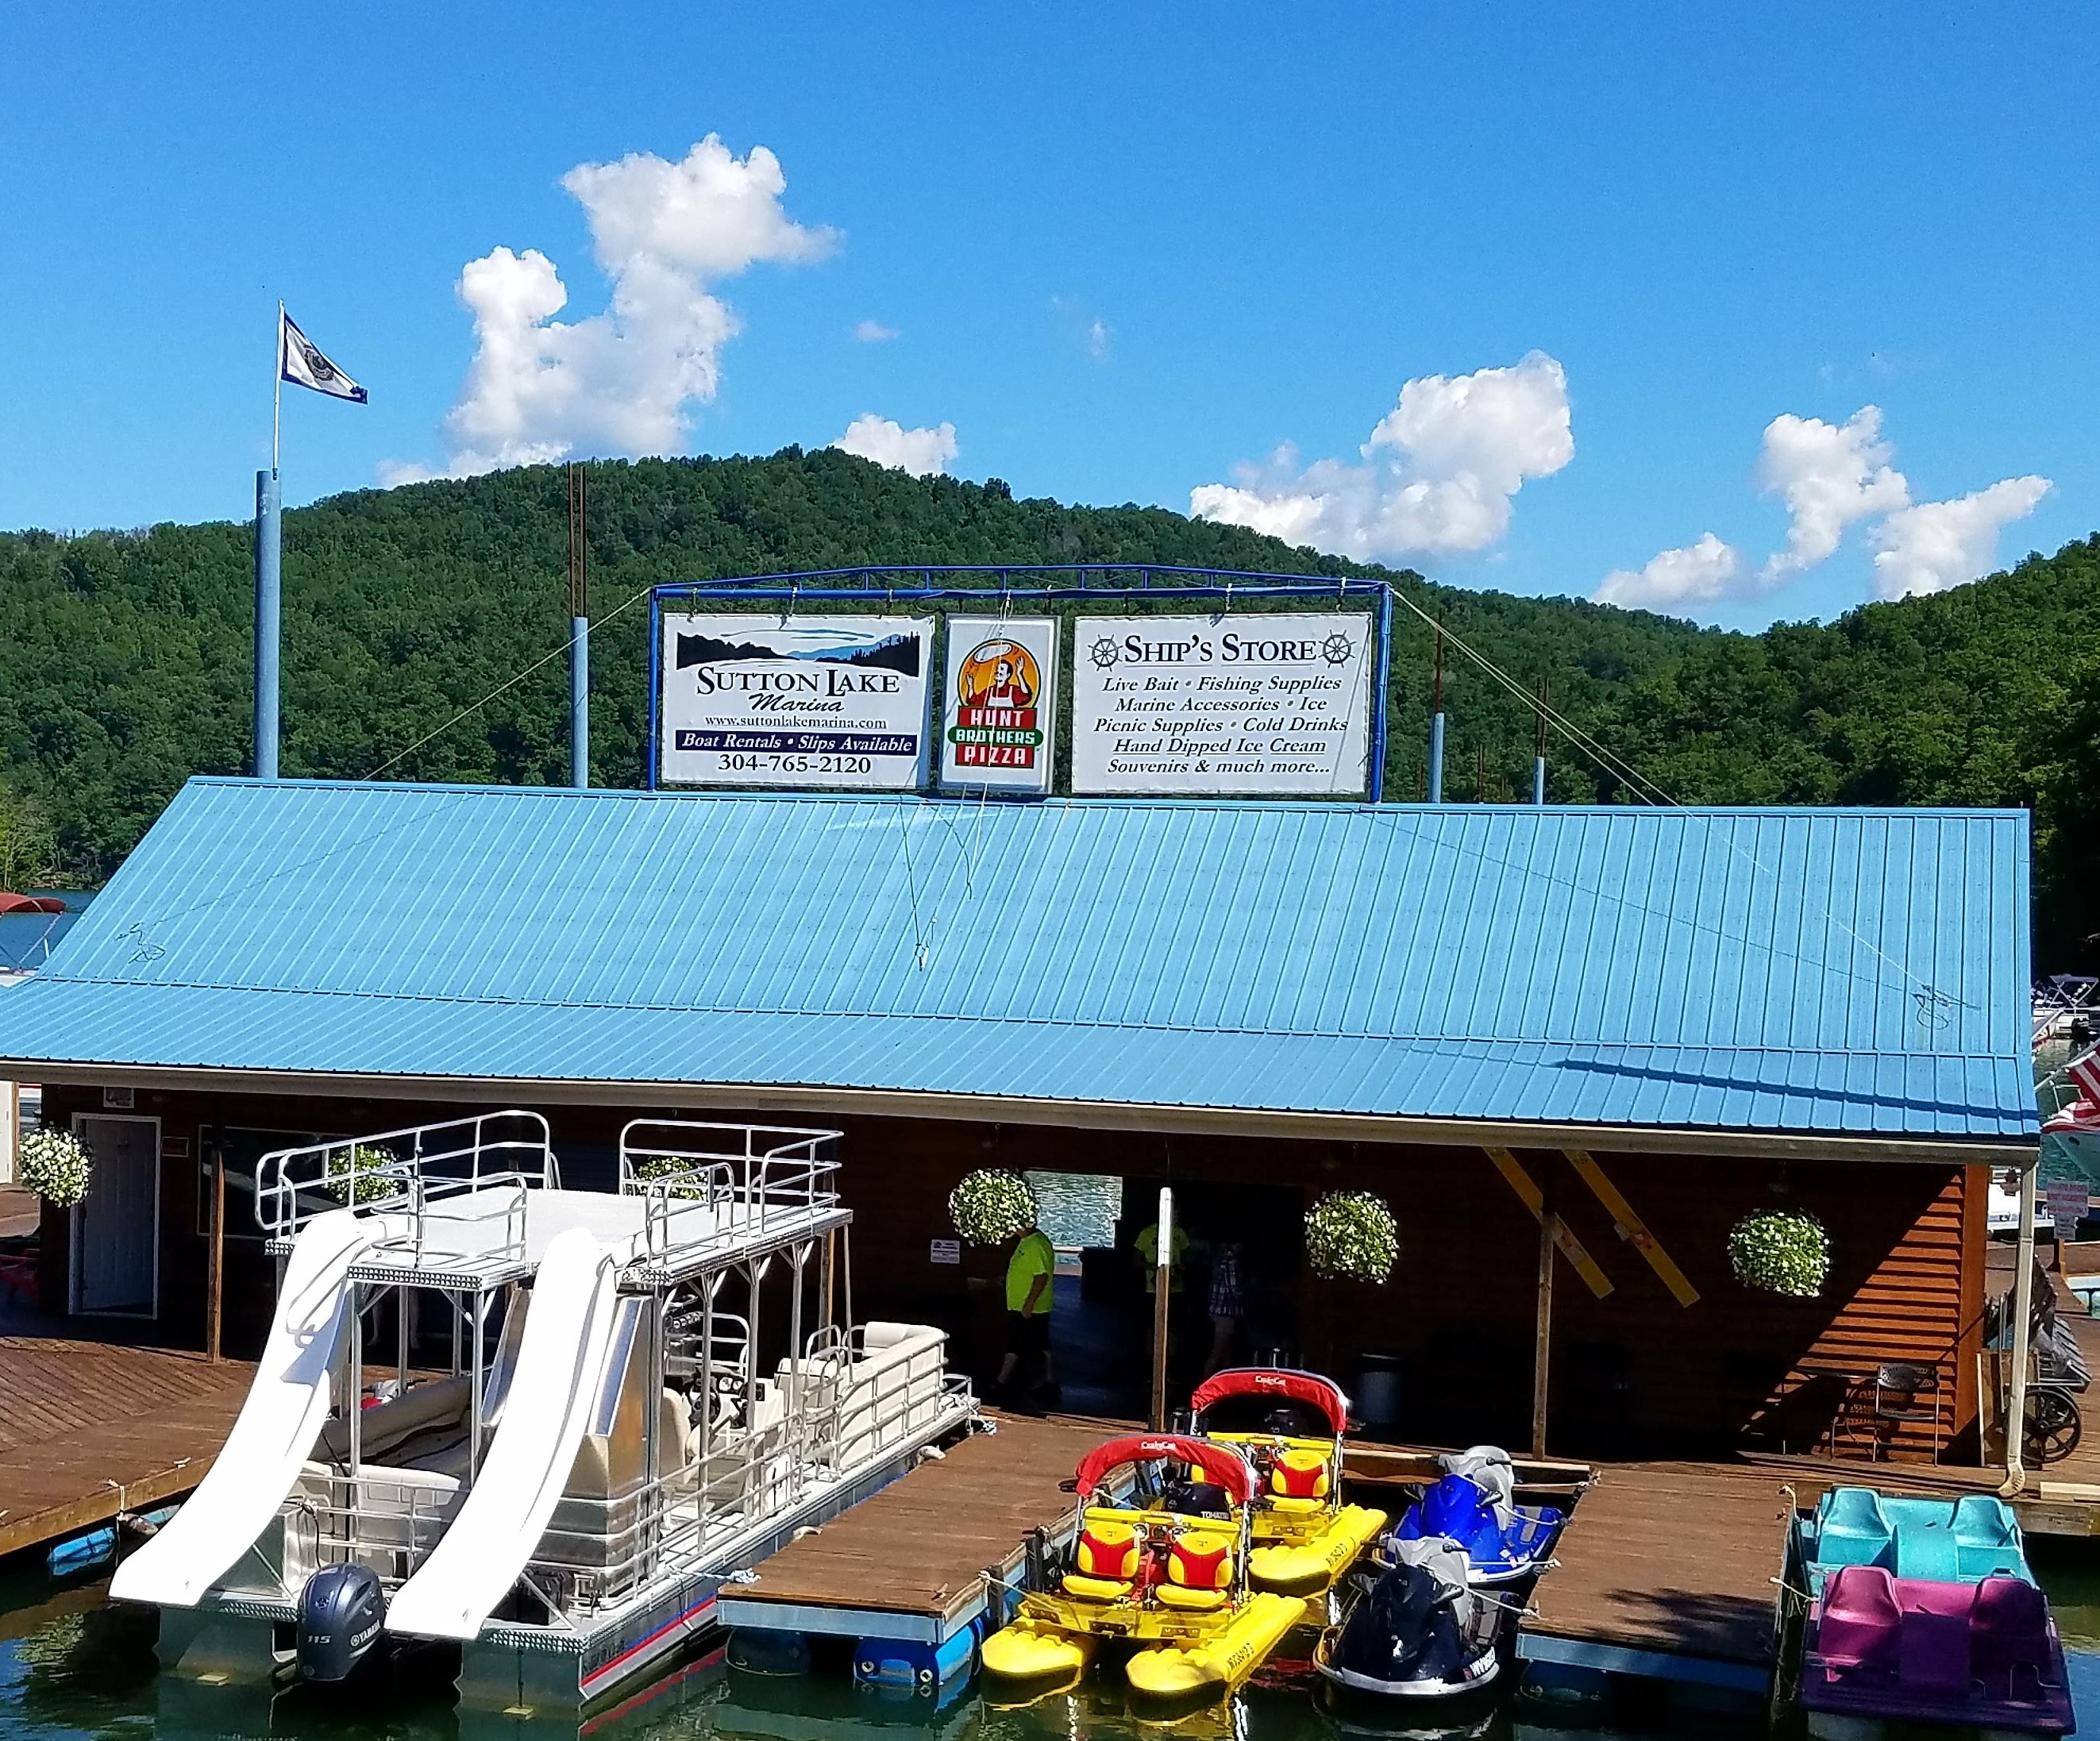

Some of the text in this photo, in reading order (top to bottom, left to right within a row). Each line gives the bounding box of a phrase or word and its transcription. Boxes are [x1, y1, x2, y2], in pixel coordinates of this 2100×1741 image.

[1124, 633, 1317, 664] SHIP'S STORE
[696, 666, 900, 696] SUTTON LAKE
[1102, 676, 1342, 695] Live Bait Fishing Supplies
[748, 692, 844, 712] Marina
[1114, 696, 1327, 711] Marine Accessories Ice
[705, 715, 887, 729] www.suttonlakemarina.com
[970, 709, 1024, 726] HUNT
[1093, 716, 1349, 735] Picnic Supplies Cold Drinks
[682, 733, 912, 753] Boat Rentals Slips Available
[956, 729, 1035, 744] BROTHERS
[964, 745, 1026, 764] PIZZA
[1113, 738, 1326, 757] Hand Dipped Ice Cream
[718, 754, 871, 774] 304-765-2120
[1108, 759, 1331, 773] Souvenirs & much more...
